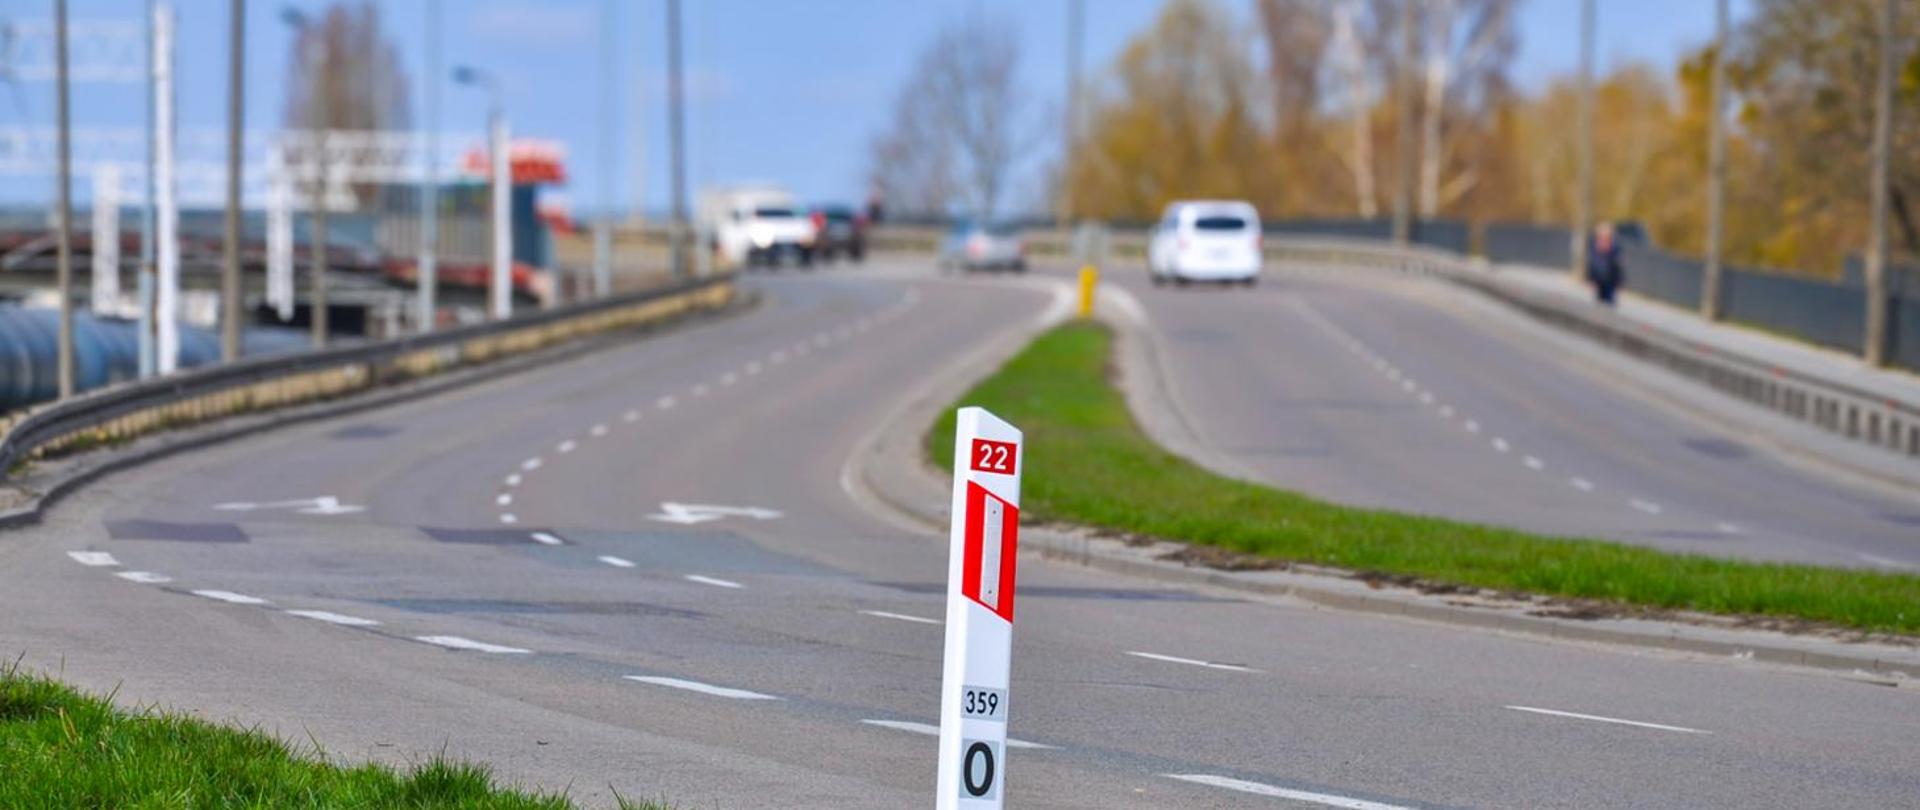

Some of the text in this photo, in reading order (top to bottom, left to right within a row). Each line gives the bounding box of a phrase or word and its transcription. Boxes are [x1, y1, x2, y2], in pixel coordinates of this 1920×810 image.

[979, 444, 1008, 470] 22
[966, 690, 998, 715] 359
[963, 742, 994, 797] 0
